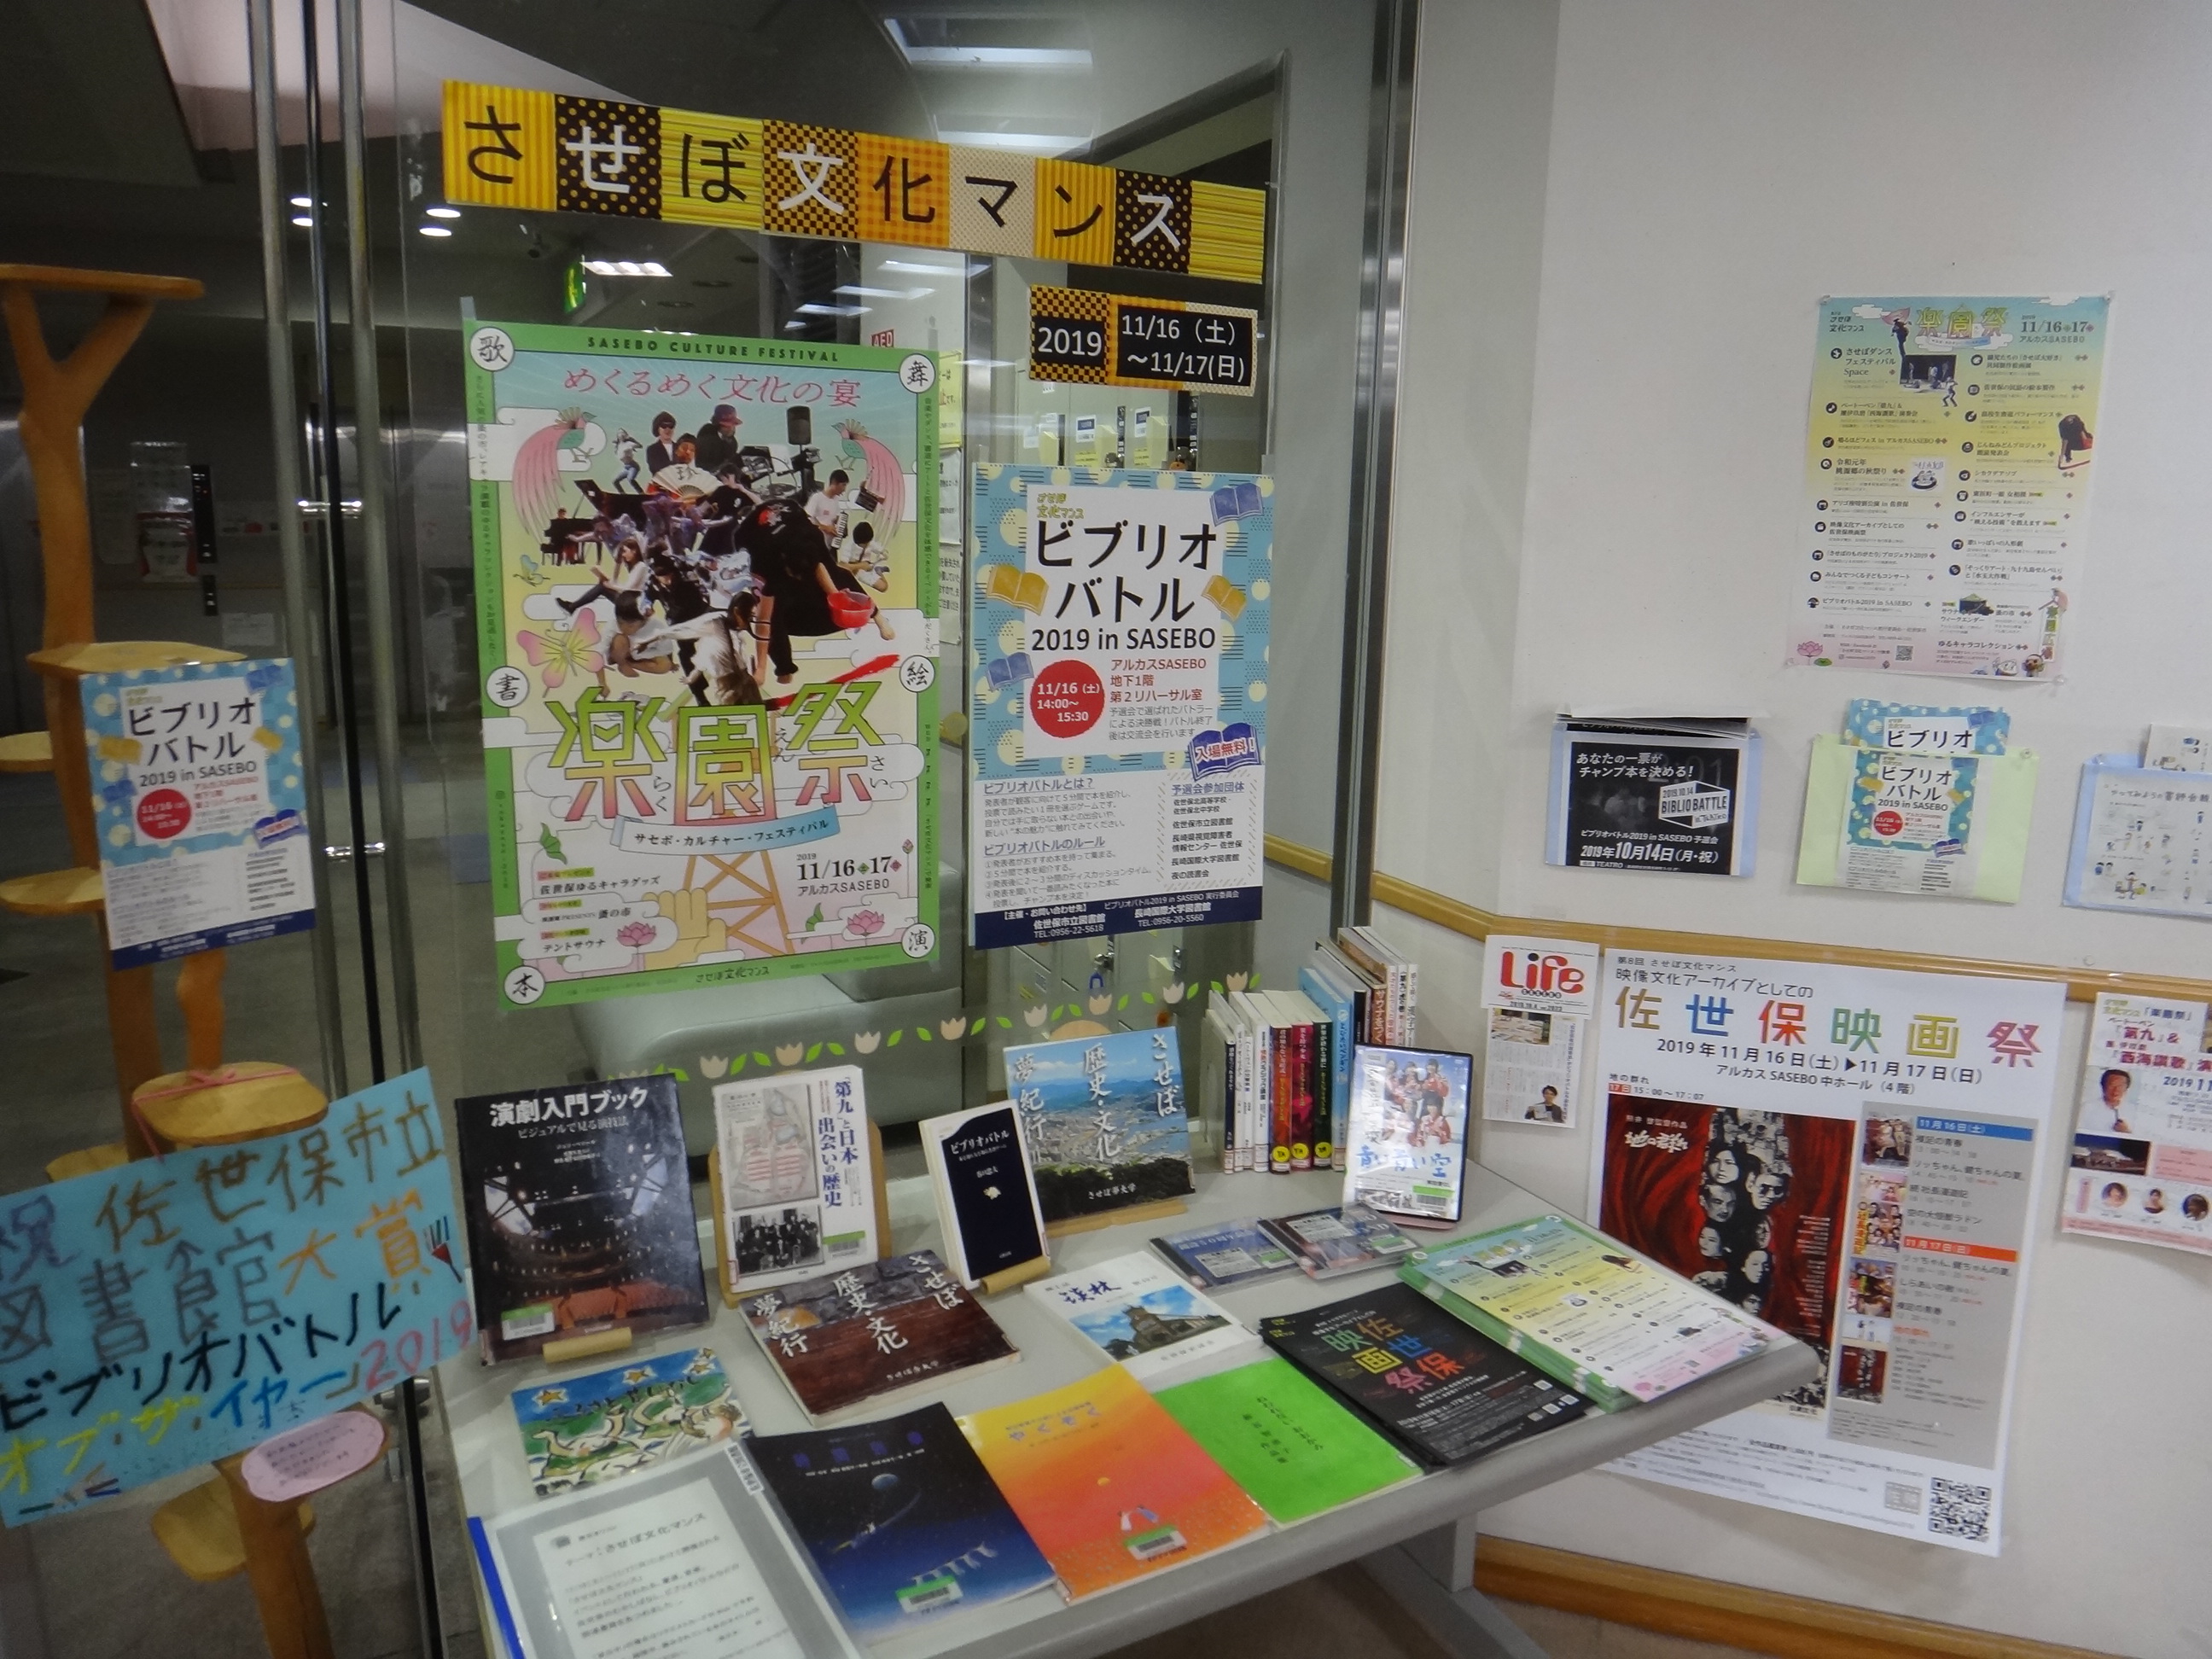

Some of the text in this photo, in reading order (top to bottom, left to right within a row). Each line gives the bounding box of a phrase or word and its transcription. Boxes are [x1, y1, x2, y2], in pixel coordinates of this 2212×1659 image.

[463, 104, 1184, 250] させぼ文化マンス
[479, 335, 509, 364] 歌
[587, 336, 841, 363] SASEBO CULTURE FESTIVAL
[1036, 323, 1103, 358] 2019
[1843, 368, 1869, 376] Space
[564, 367, 862, 407] めくるめく文化の宴
[1038, 519, 1217, 571] ビブリオ
[1055, 576, 1196, 623] バトル
[1031, 627, 1216, 651] 2019 in SASEBO
[905, 661, 930, 687] 絵
[1110, 658, 1207, 671] アルカスSASEBO
[127, 696, 257, 737] ビブリオ
[1057, 711, 1090, 723] 15:30
[147, 731, 246, 766] バトル
[544, 680, 894, 826] 楽園祭
[1887, 729, 1973, 749] ビブリオ
[1576, 752, 1662, 765] あなたの一票が
[138, 760, 258, 789] 2019 in SASEBO
[1882, 766, 1953, 786] ビブリオ
[1886, 785, 1942, 801] バトル
[983, 837, 1106, 857] ビブリオバトルのルール
[1658, 834, 1692, 844] SASEBO
[797, 879, 891, 897] アルカスSASEBO
[695, 965, 771, 984] させぼ文化マンス
[1500, 951, 1585, 994] Life
[1650, 958, 1738, 973] させぼ文化マンス
[512, 972, 539, 999] 本
[1615, 968, 1814, 999] 映像文化アーカイブとしての
[1615, 986, 2042, 1068] 佐世保映画祭
[1151, 1033, 1179, 1118] させぼ
[489, 1086, 650, 1128] 演劇入門ブック
[949, 1128, 1010, 1156] ビブリオバトル
[95, 1090, 446, 1253] 佐世保市立
[0, 1282, 402, 1432] ビブリオバトル
